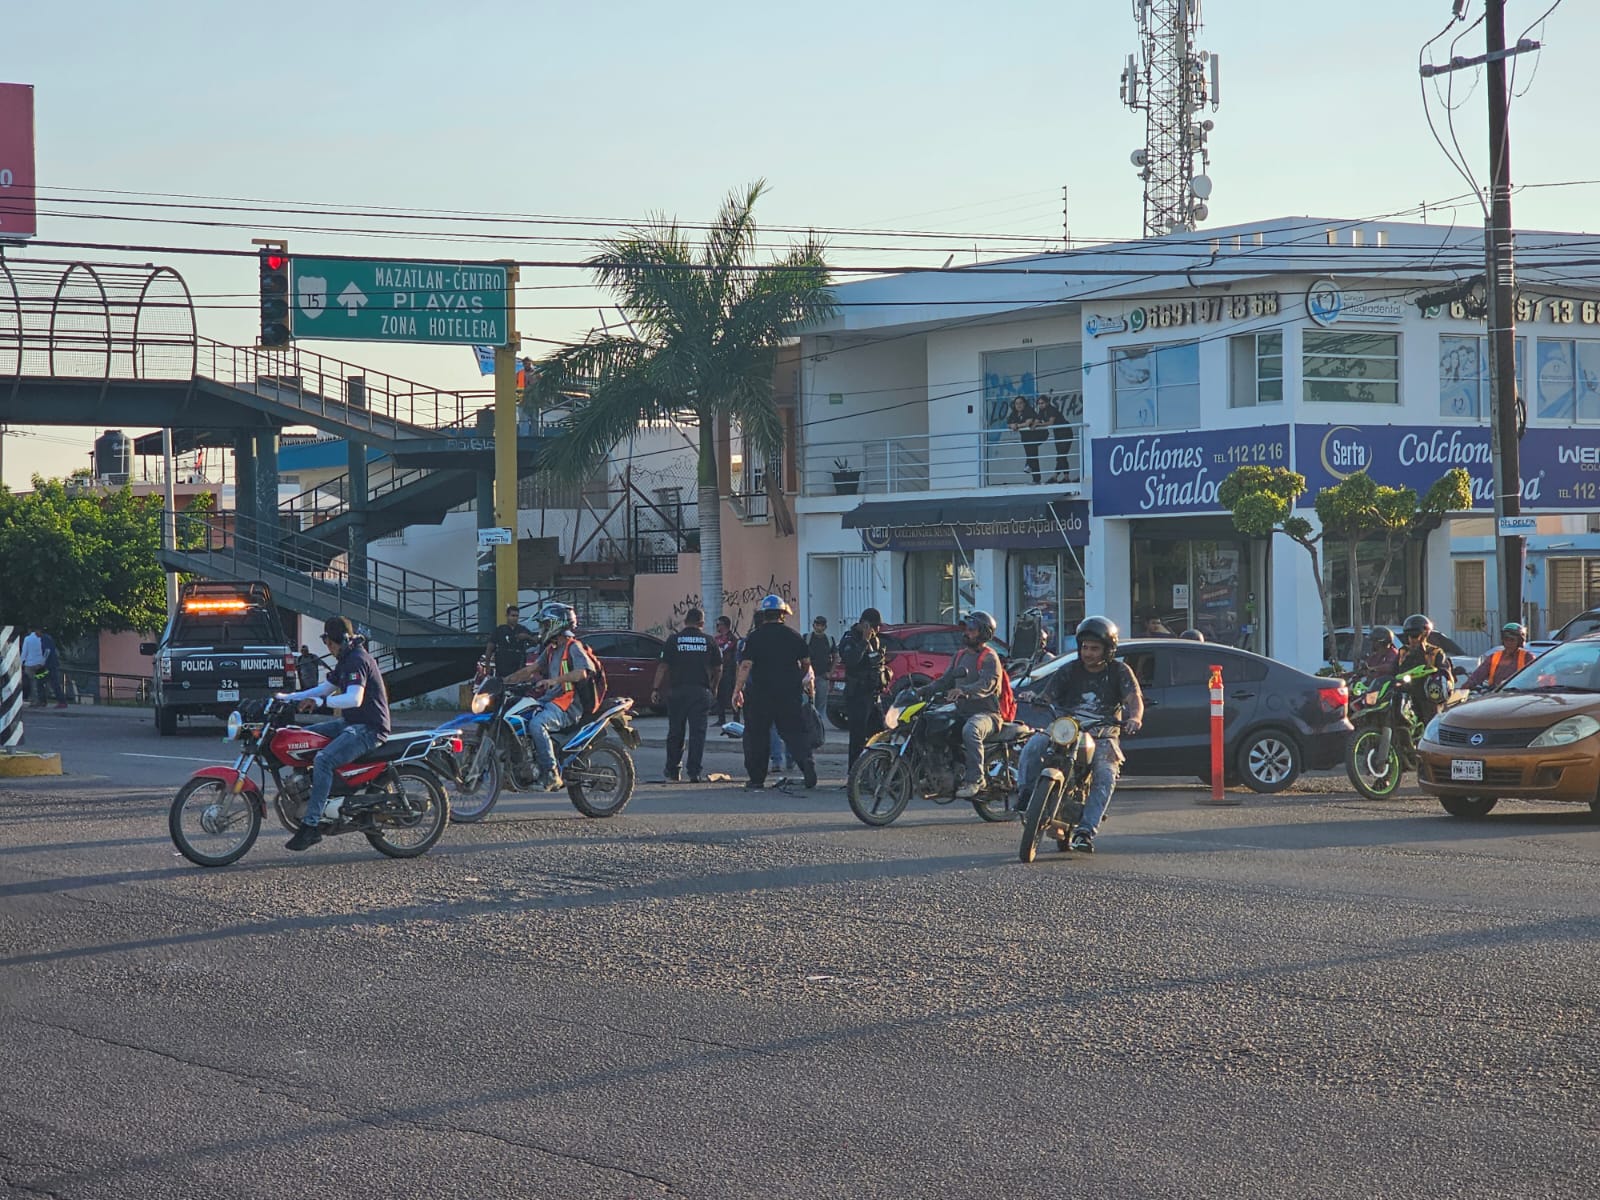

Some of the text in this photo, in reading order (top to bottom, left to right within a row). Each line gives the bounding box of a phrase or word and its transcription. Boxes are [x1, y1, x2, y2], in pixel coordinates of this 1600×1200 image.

[375, 267, 501, 292] MAZATLAN-CENTRO
[307, 294, 319, 308] 15
[393, 293, 484, 314] PLAYAS
[1550, 300, 1574, 323] 13
[381, 315, 497, 338] ZONA HOTELERA
[1109, 438, 1203, 477] Colchones
[1228, 446, 1248, 463] 112
[1251, 443, 1266, 461] 12
[1268, 442, 1283, 460] 16
[1333, 439, 1365, 466] Serta
[1399, 430, 1493, 466] Colchon
[1573, 481, 1596, 500] 112
[965, 522, 1009, 537] Sistema
[1011, 520, 1026, 534] de
[677, 636, 707, 644] BOMBEROS
[181, 658, 284, 671] POLICÍA MUNICIPAL
